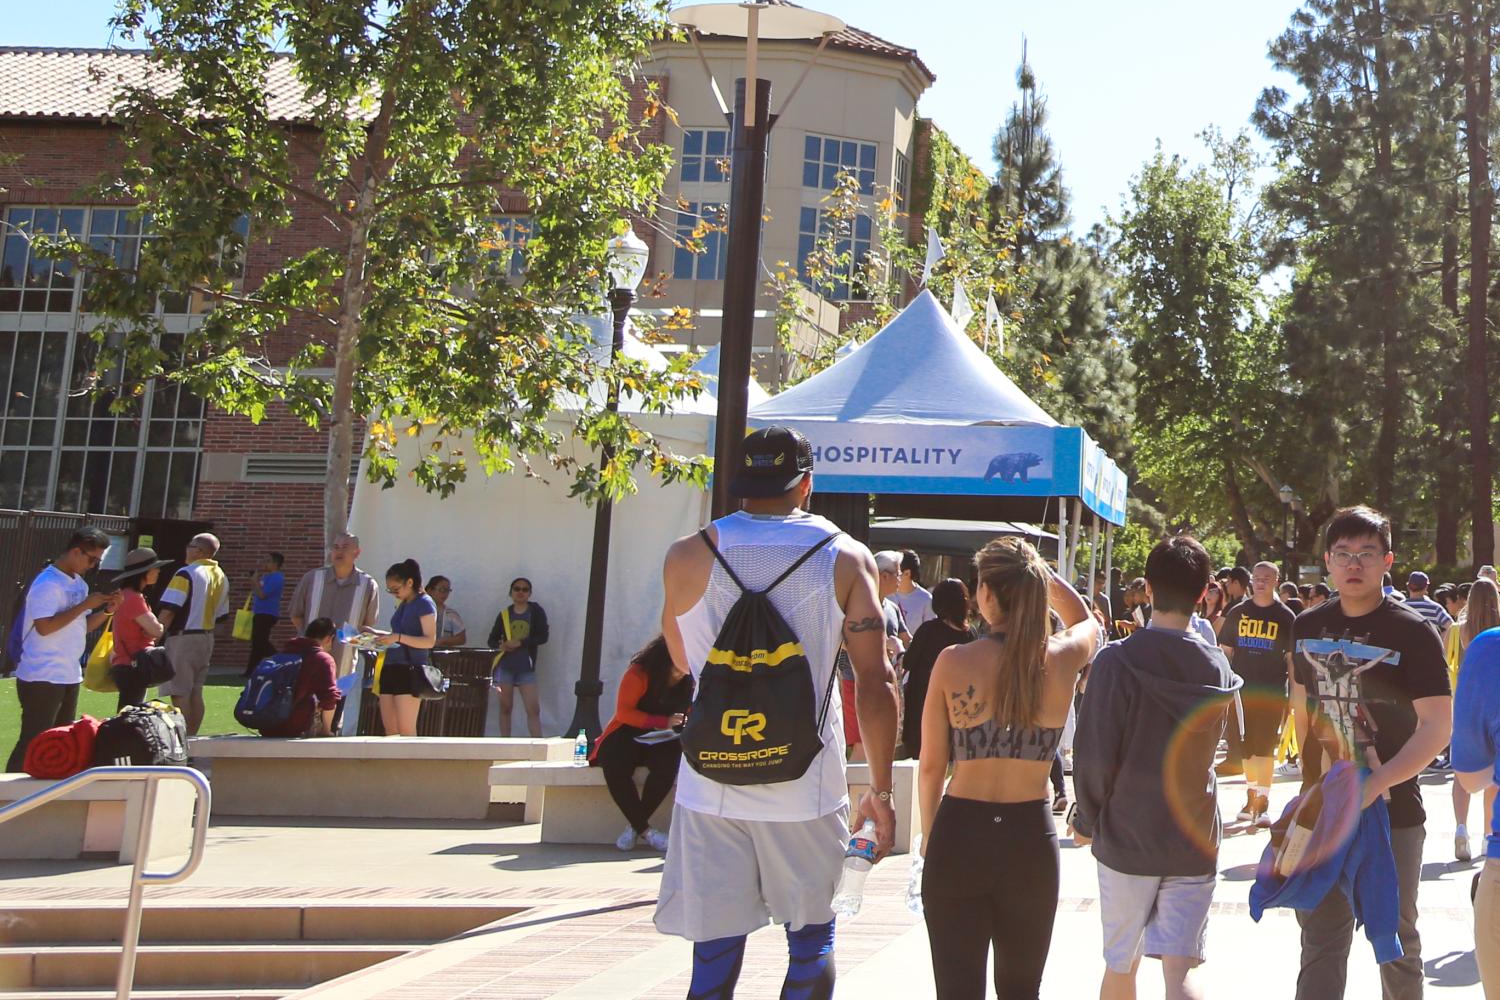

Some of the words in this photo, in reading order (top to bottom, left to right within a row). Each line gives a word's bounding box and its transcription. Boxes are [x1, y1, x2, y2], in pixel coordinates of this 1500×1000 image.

[1238, 619, 1279, 640] GOLD
[699, 745, 789, 761] CROSSROPE
[767, 759, 783, 767] JUMP
